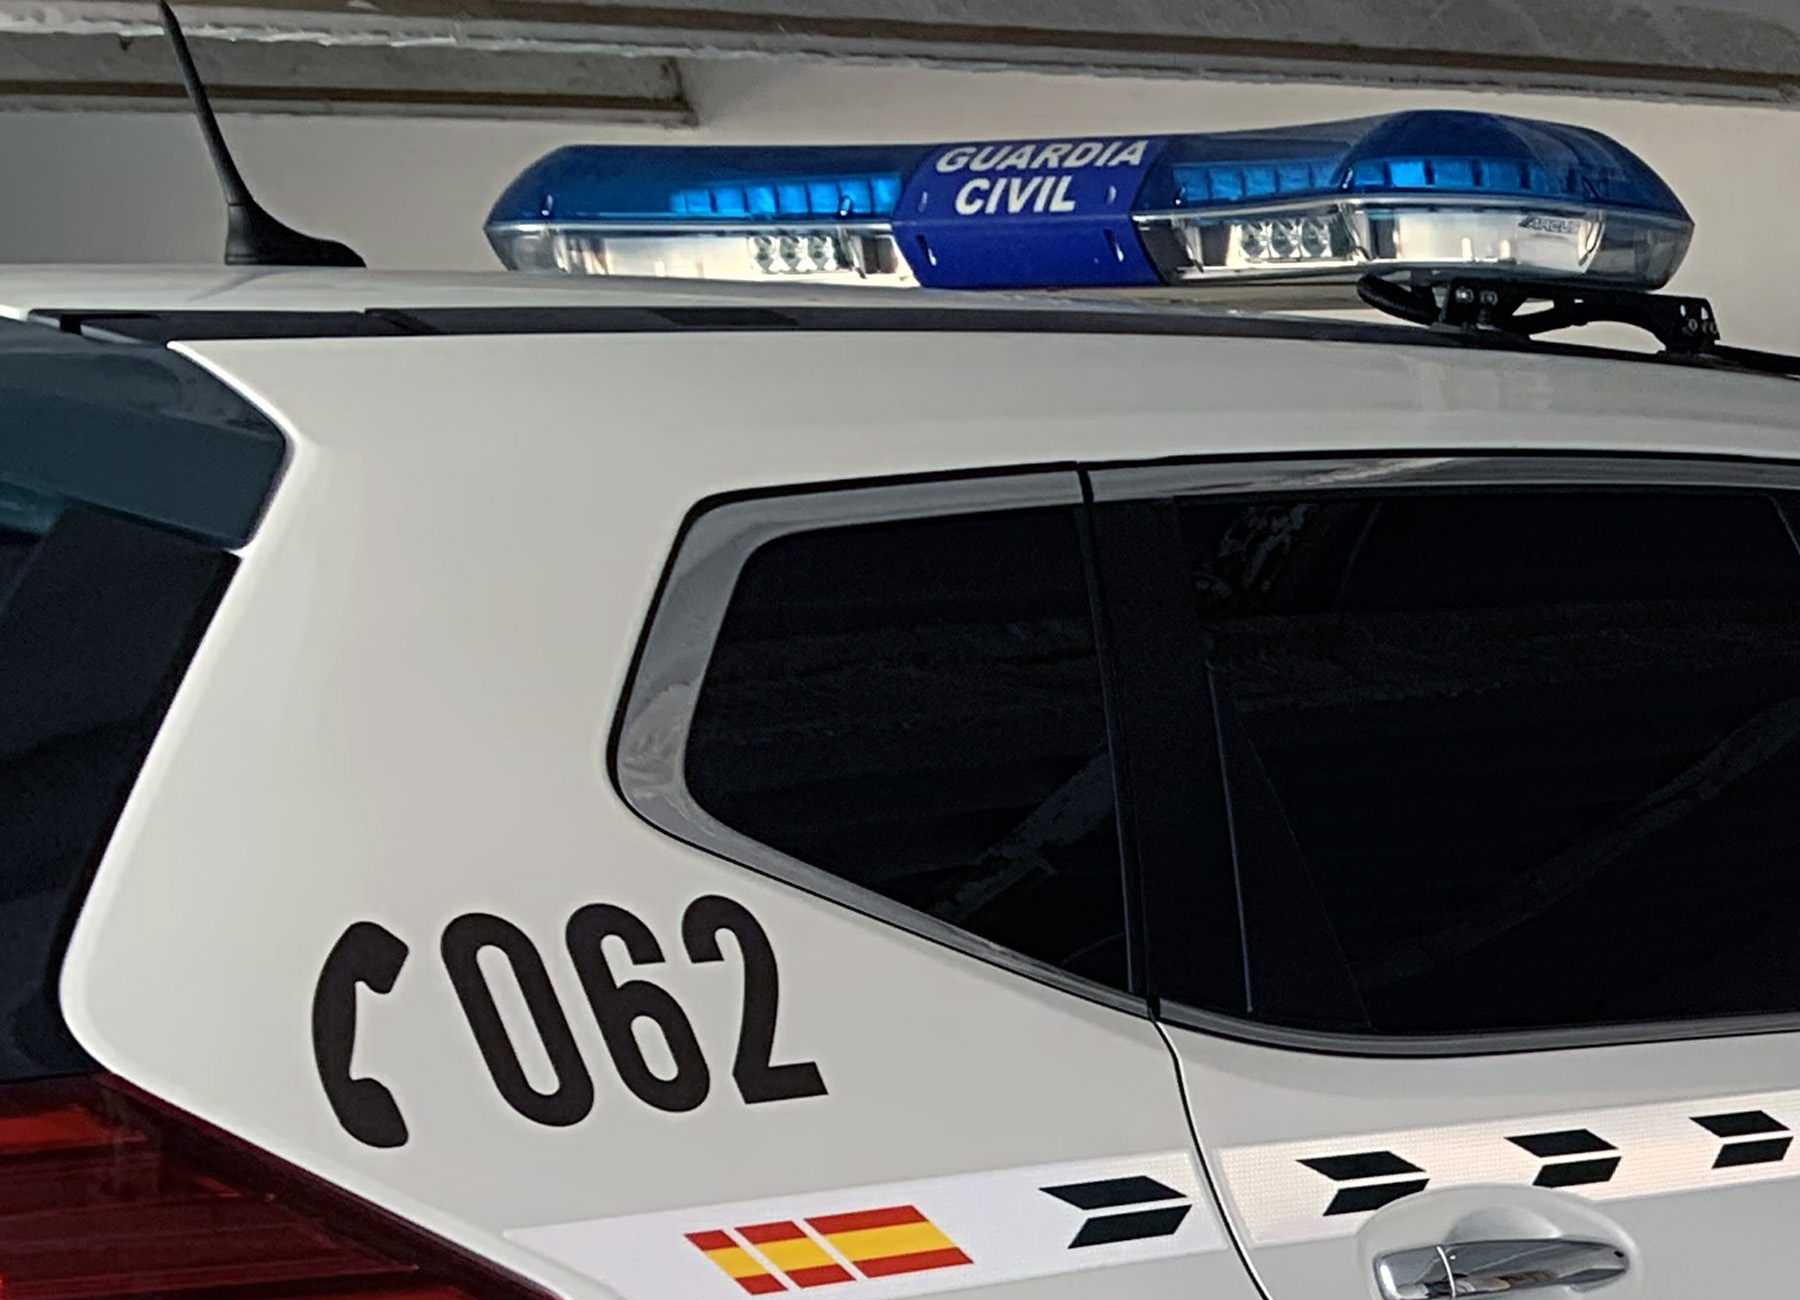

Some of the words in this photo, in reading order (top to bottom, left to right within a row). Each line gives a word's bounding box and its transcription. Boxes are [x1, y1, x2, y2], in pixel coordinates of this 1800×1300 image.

[936, 140, 1149, 173] GUARDIA
[955, 175, 1076, 215] CIVIL
[440, 894, 829, 1127] 062
